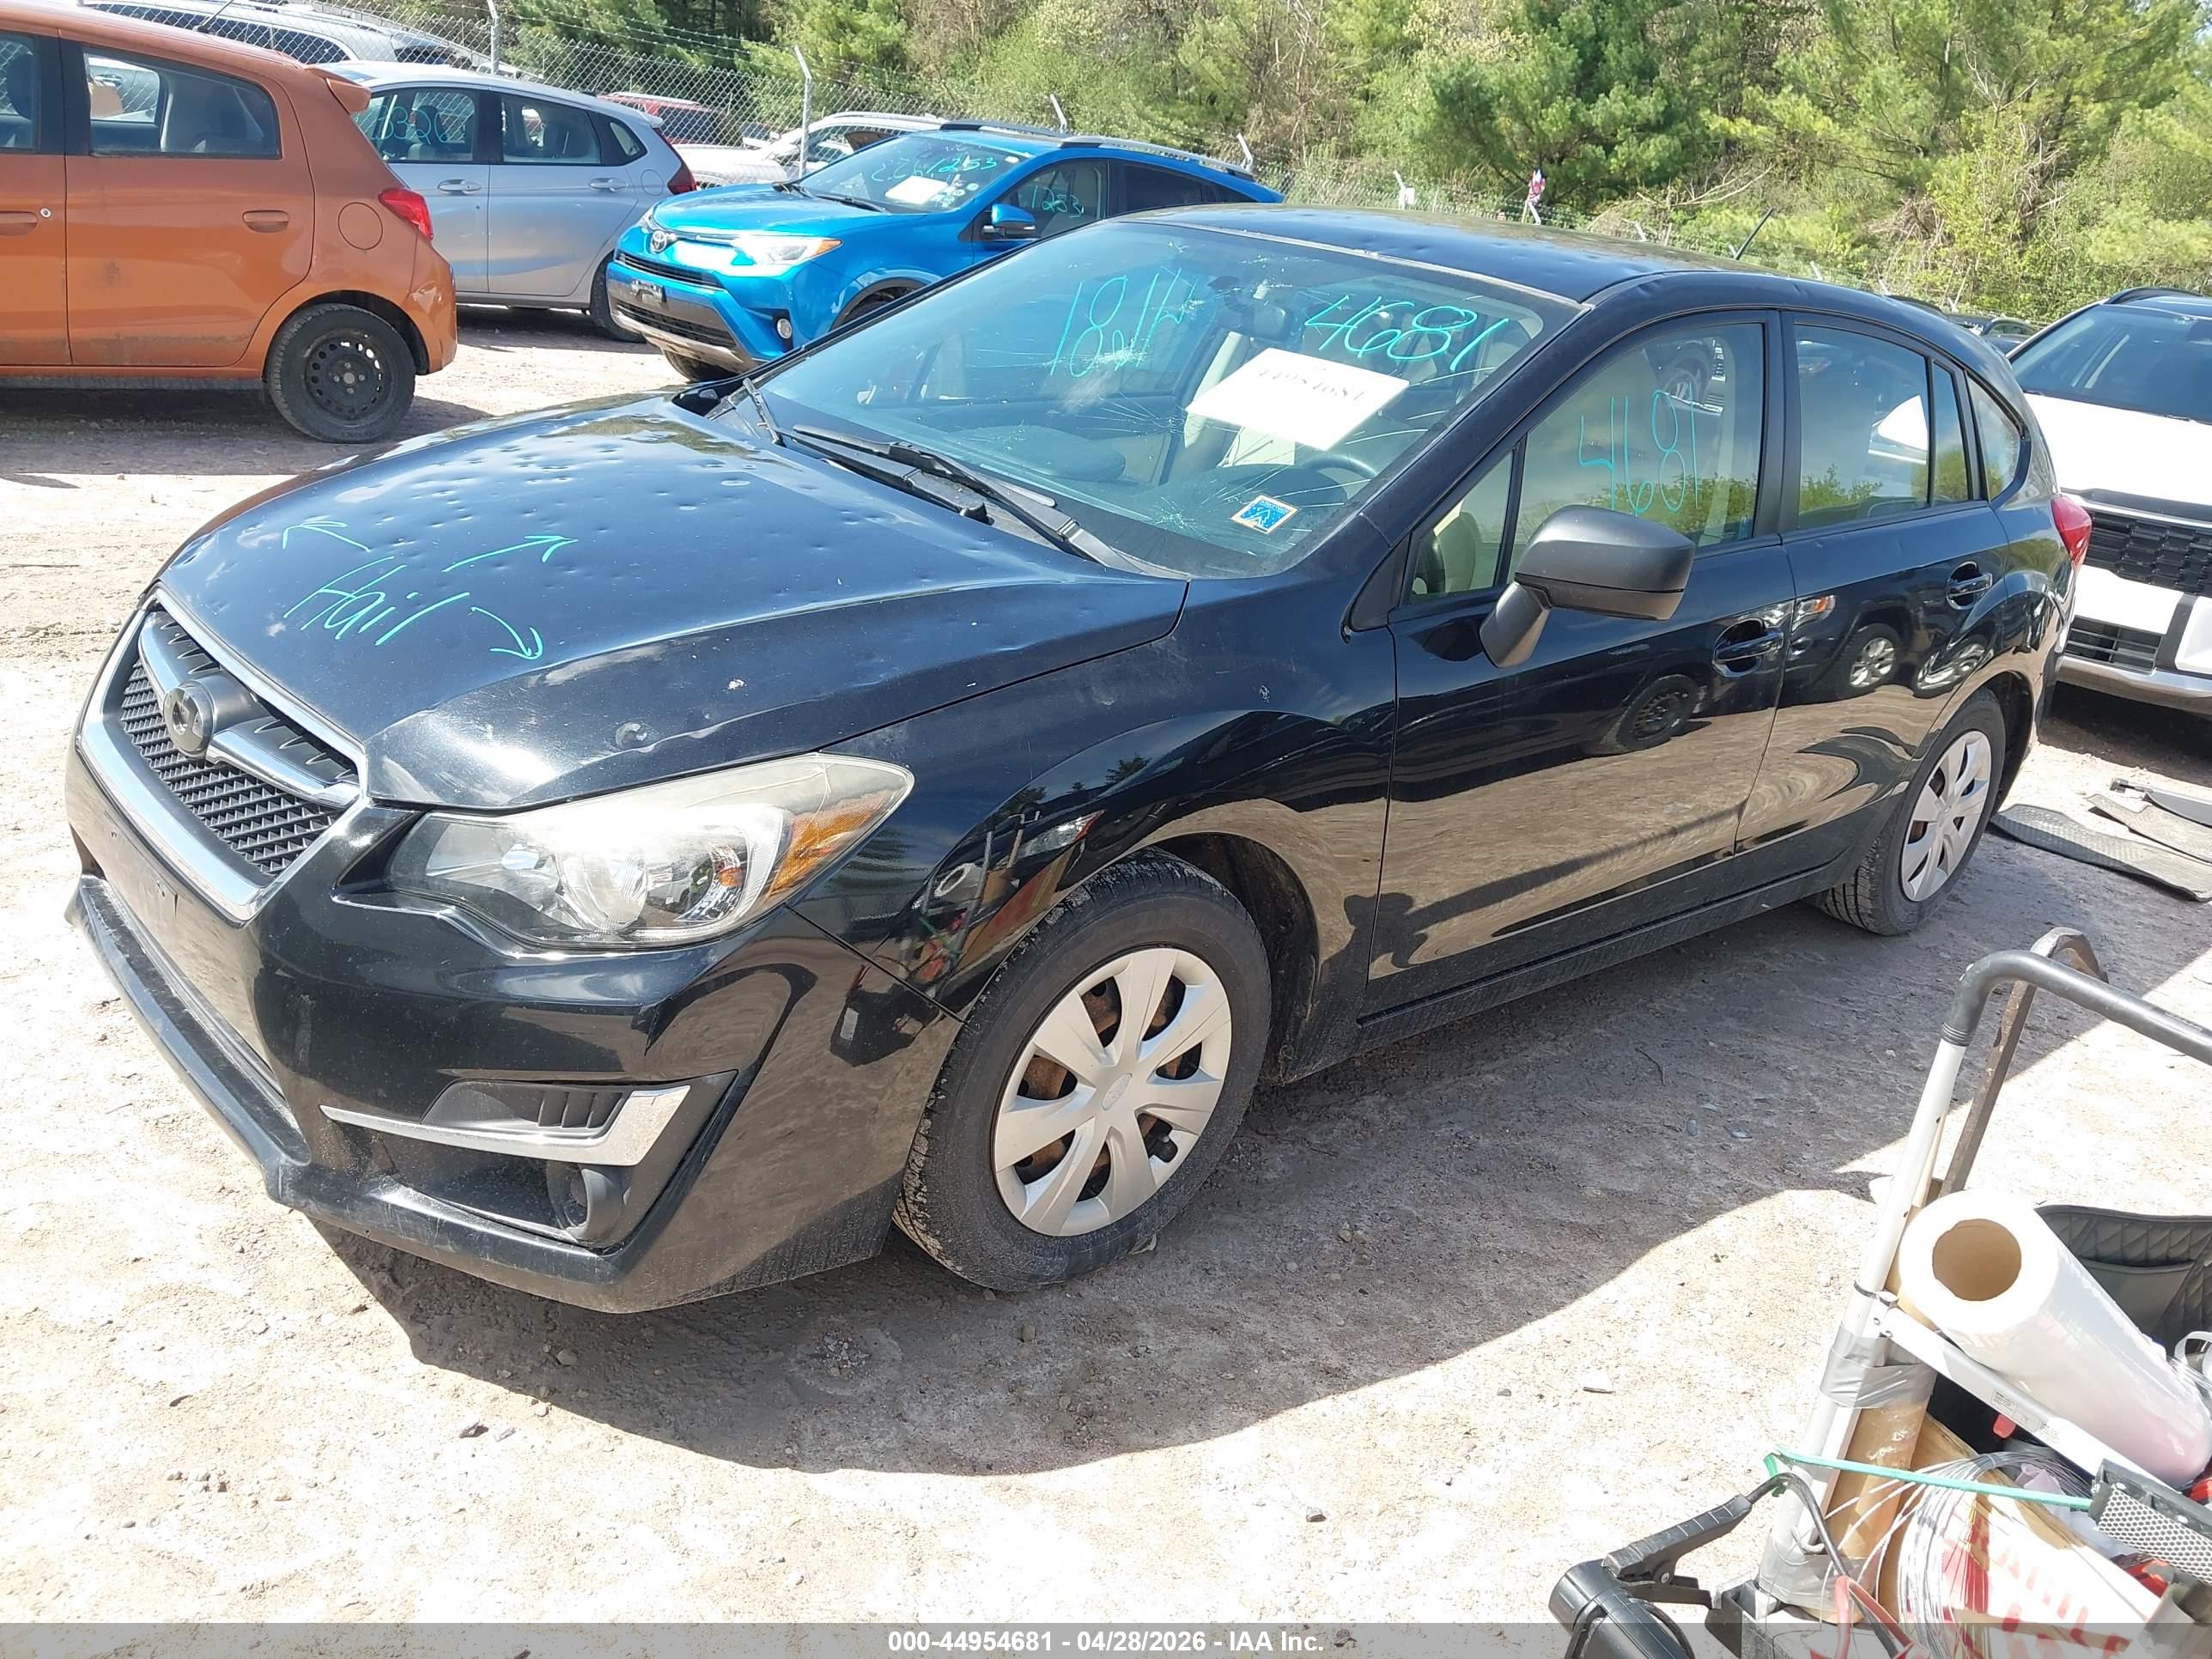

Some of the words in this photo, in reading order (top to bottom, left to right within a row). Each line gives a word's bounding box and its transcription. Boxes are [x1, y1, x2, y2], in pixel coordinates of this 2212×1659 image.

[1031, 185, 1082, 219] 1253
[1304, 295, 1510, 372] 4681
[1578, 380, 1698, 517] 4681
[283, 556, 470, 646] Hail
